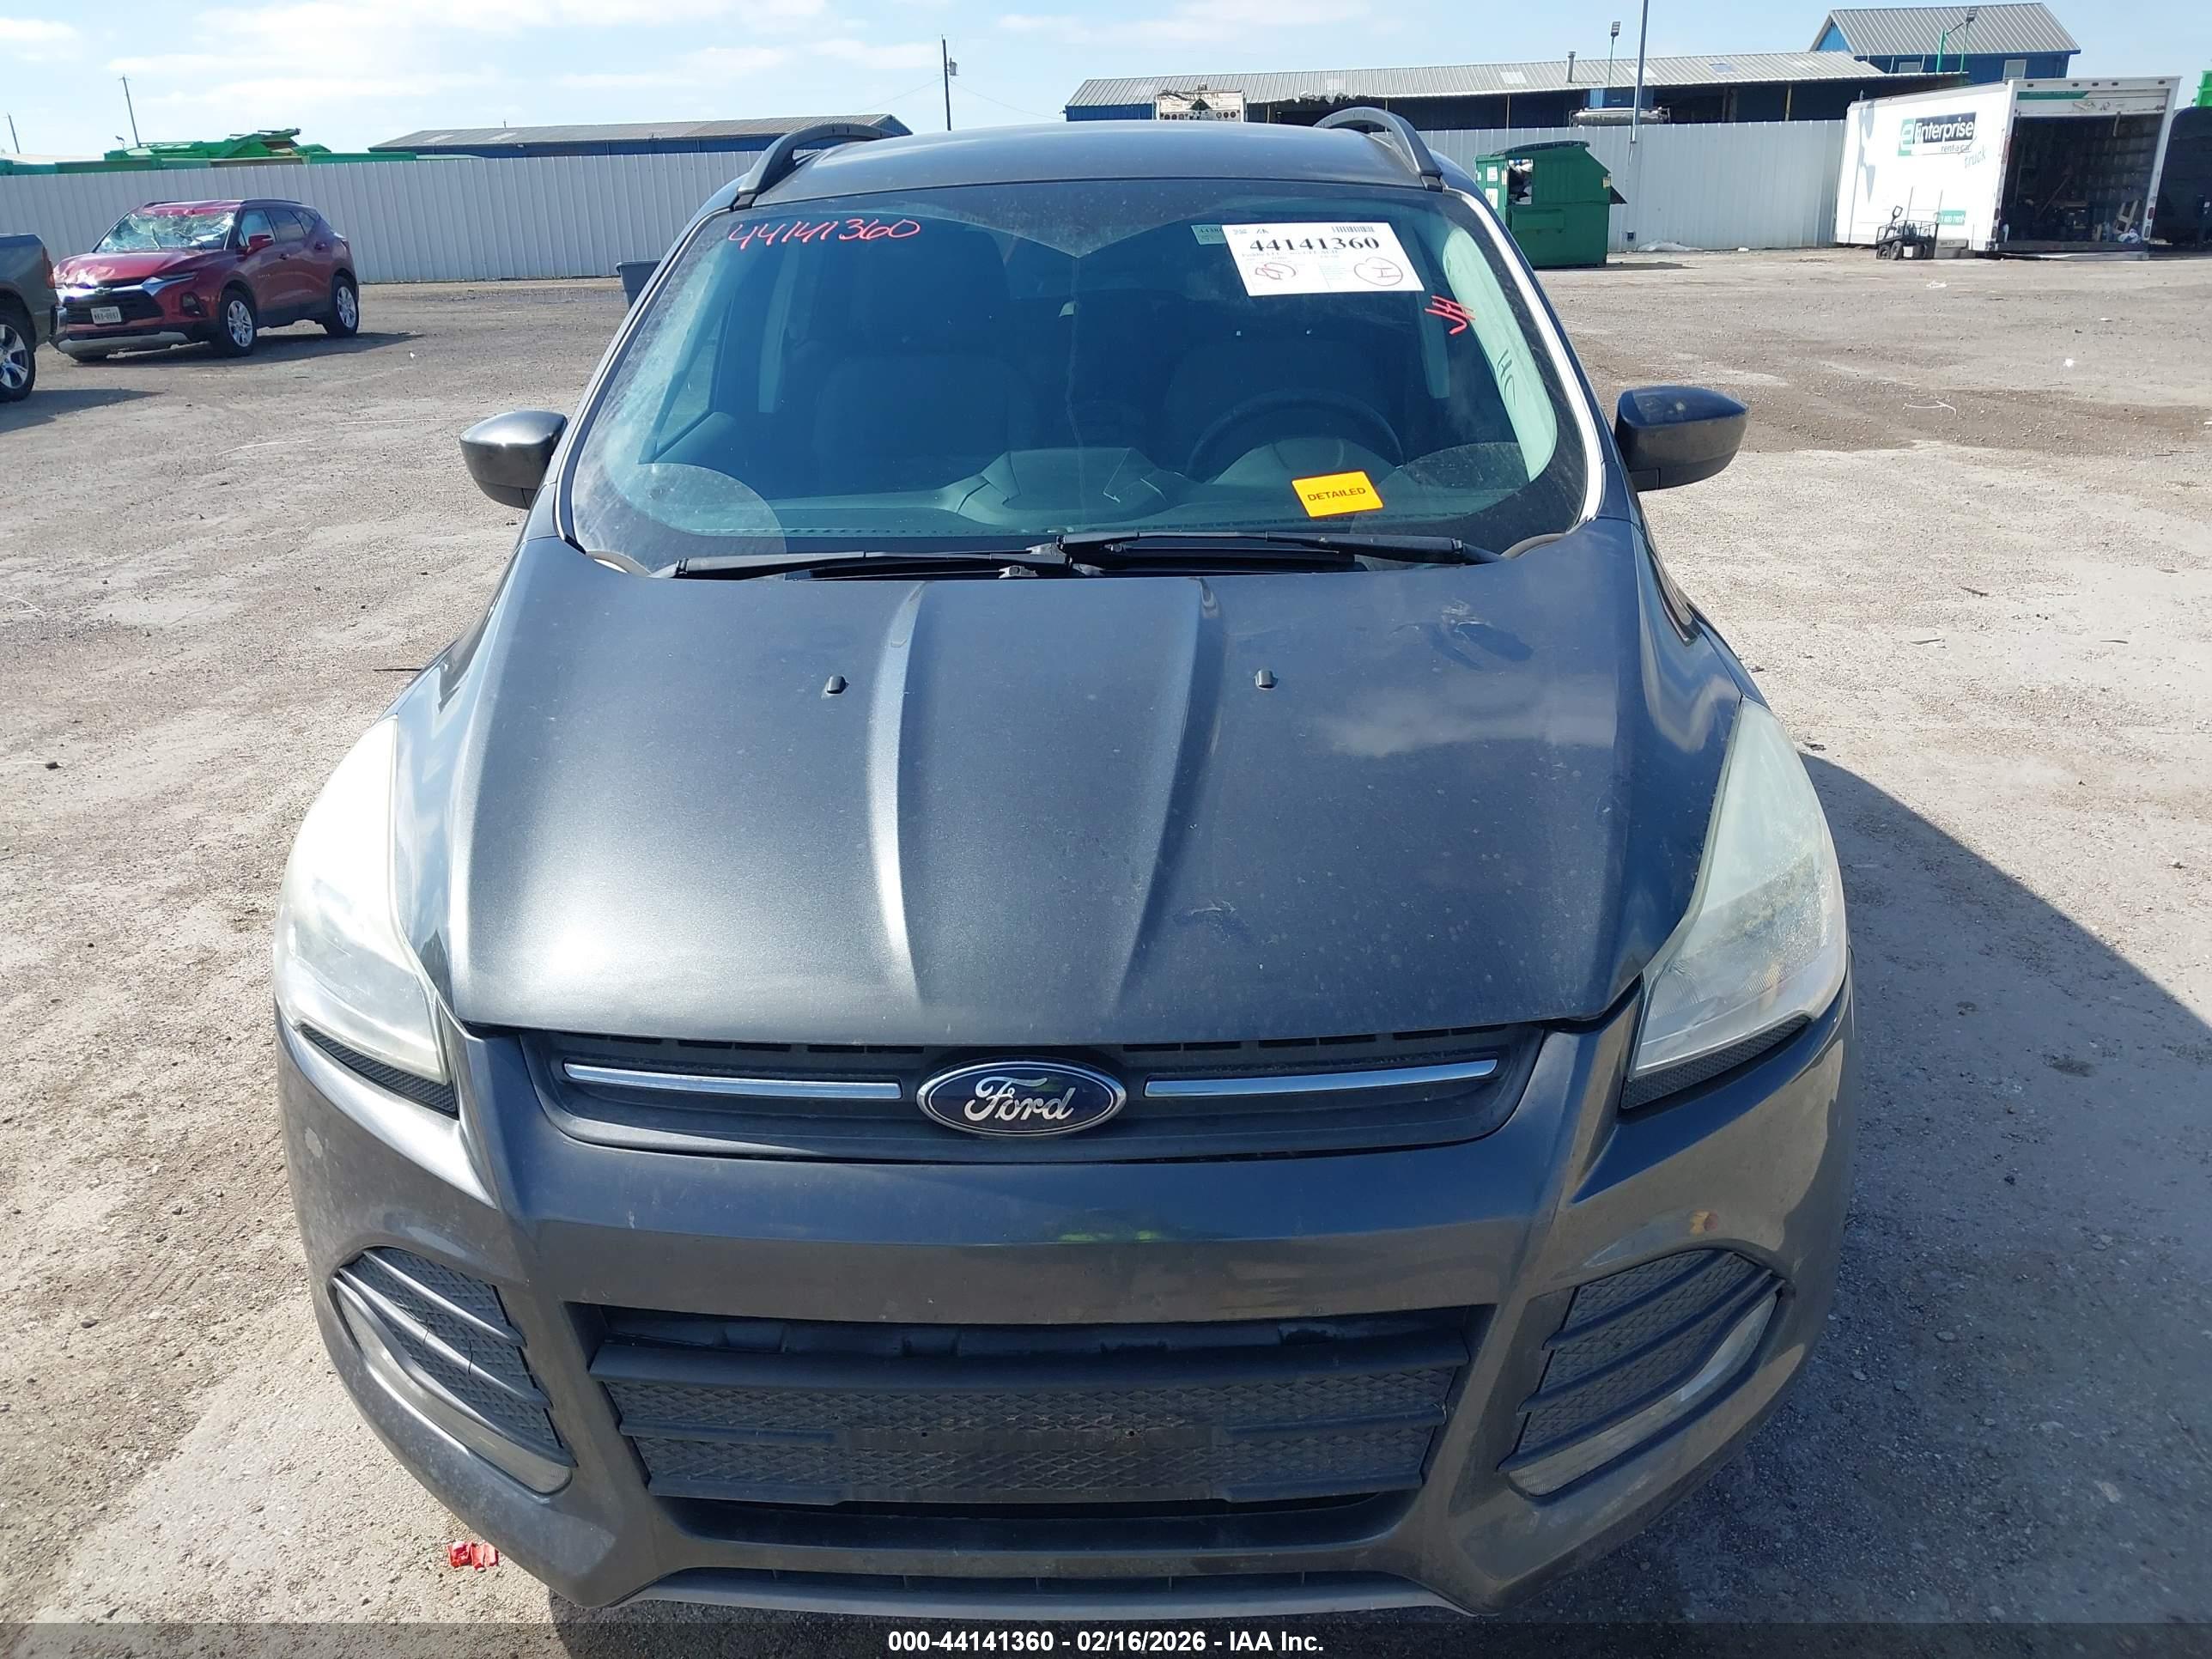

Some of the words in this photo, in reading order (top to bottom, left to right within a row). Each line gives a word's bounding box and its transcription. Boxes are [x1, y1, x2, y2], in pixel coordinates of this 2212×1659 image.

[1915, 117, 1975, 143] Enterprise
[728, 218, 921, 251] 44141360
[1249, 237, 1379, 252] 44141360
[1307, 487, 1366, 501] DETAILED
[963, 1075, 1077, 1121] Ford
